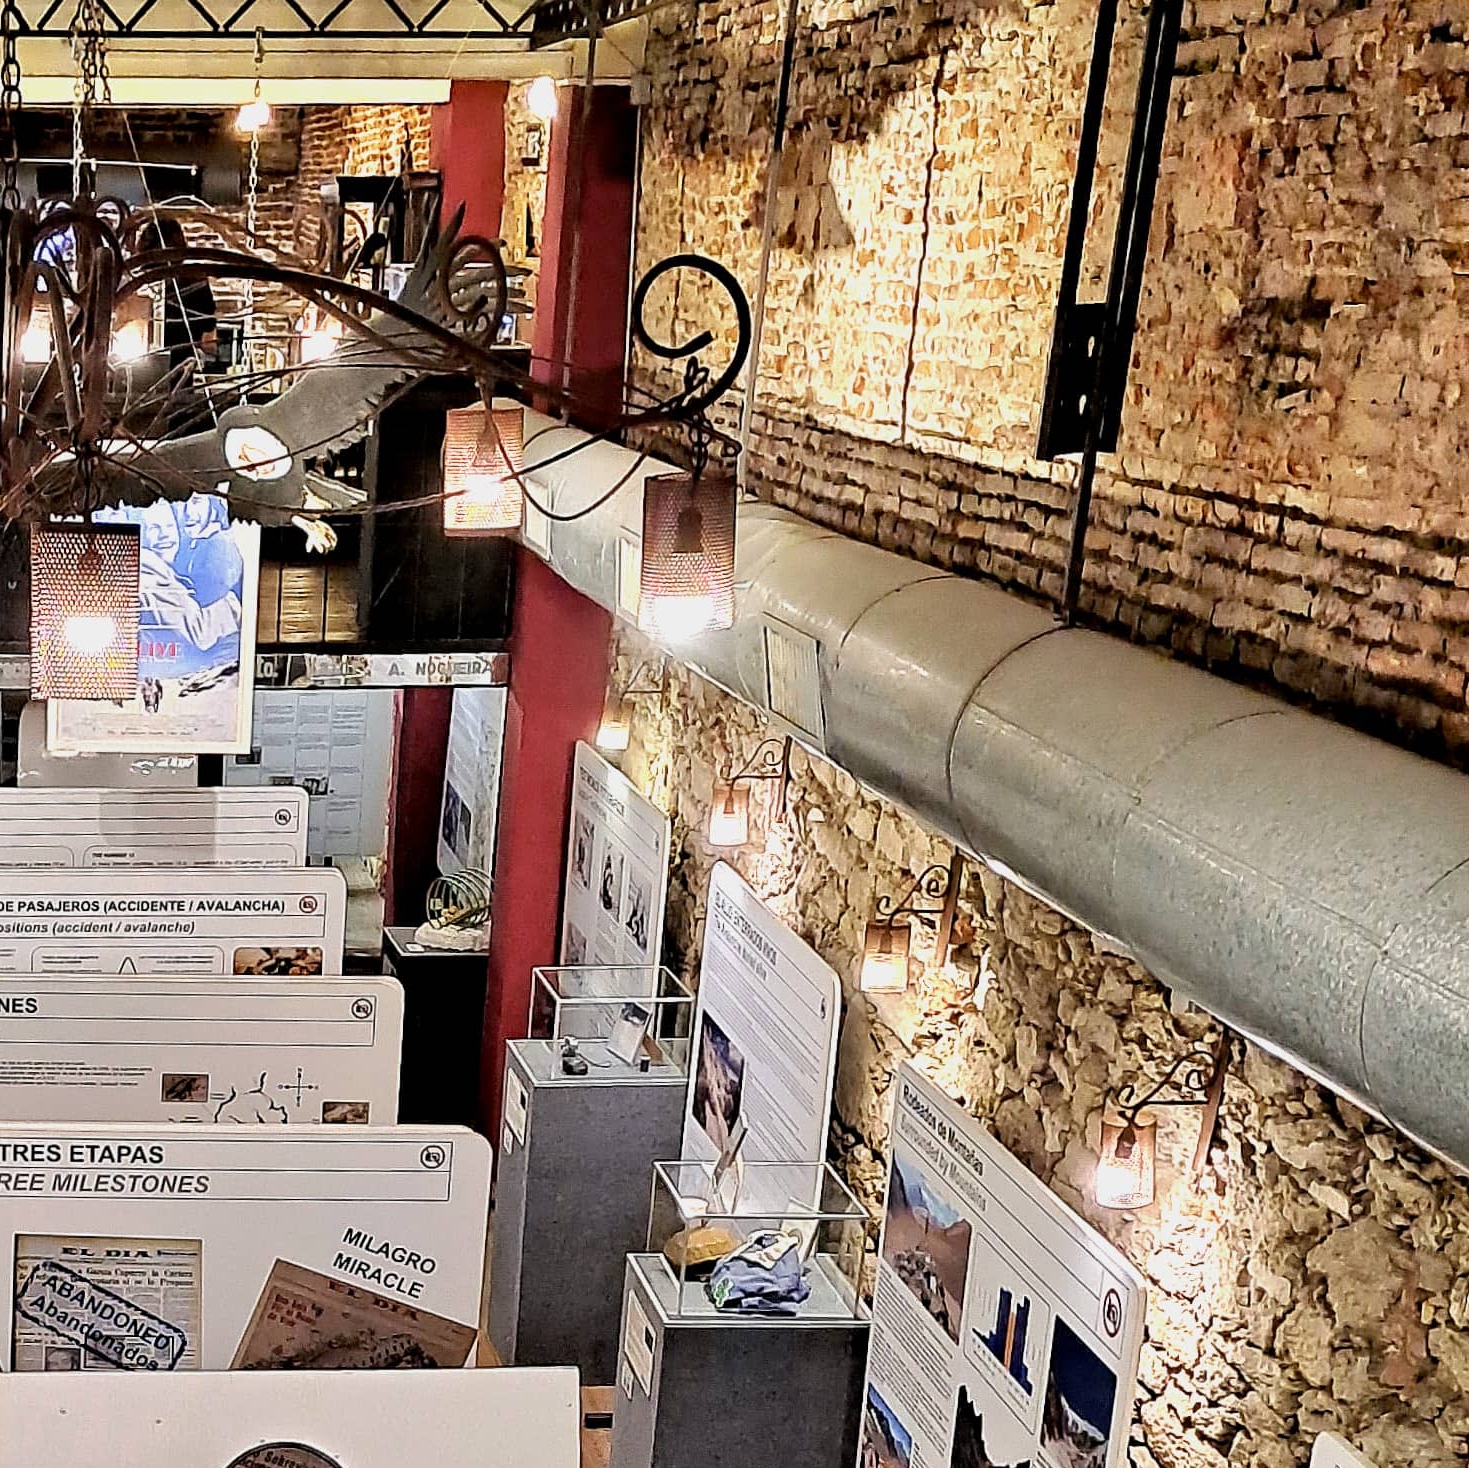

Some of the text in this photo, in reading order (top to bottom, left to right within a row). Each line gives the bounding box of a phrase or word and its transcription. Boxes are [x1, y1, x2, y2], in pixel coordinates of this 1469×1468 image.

[16, 900, 100, 914] PASAJEROS
[103, 898, 186, 916] (ACCIDENTE
[196, 898, 285, 916] AVALANCHA)
[52, 920, 112, 936] (accident
[124, 920, 195, 936] avalanche)
[68, 1144, 165, 1164] ETAPAS
[51, 1173, 210, 1194] MILESTONES
[61, 1247, 96, 1257] EL
[104, 1249, 153, 1258] DIA
[343, 1228, 436, 1275] MILAGRO
[333, 1252, 424, 1299] MIRACLE
[42, 1274, 170, 1350] ABANDONED
[30, 1295, 159, 1371] Abandonados
